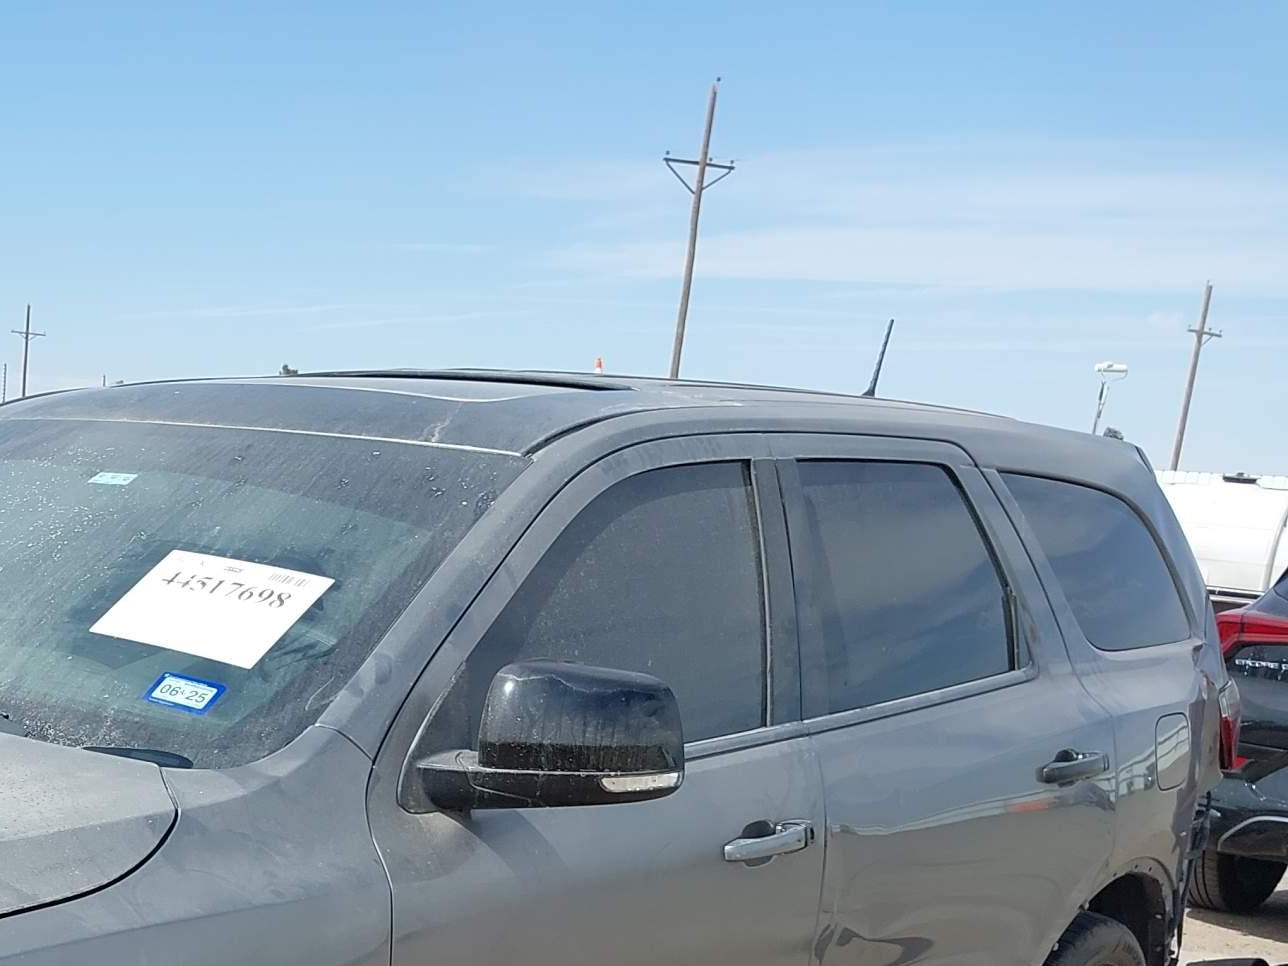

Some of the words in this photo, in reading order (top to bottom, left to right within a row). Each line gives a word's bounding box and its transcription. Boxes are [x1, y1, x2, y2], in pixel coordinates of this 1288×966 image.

[161, 571, 292, 608] 44517698
[159, 683, 182, 697] 06
[185, 690, 209, 703] 25
